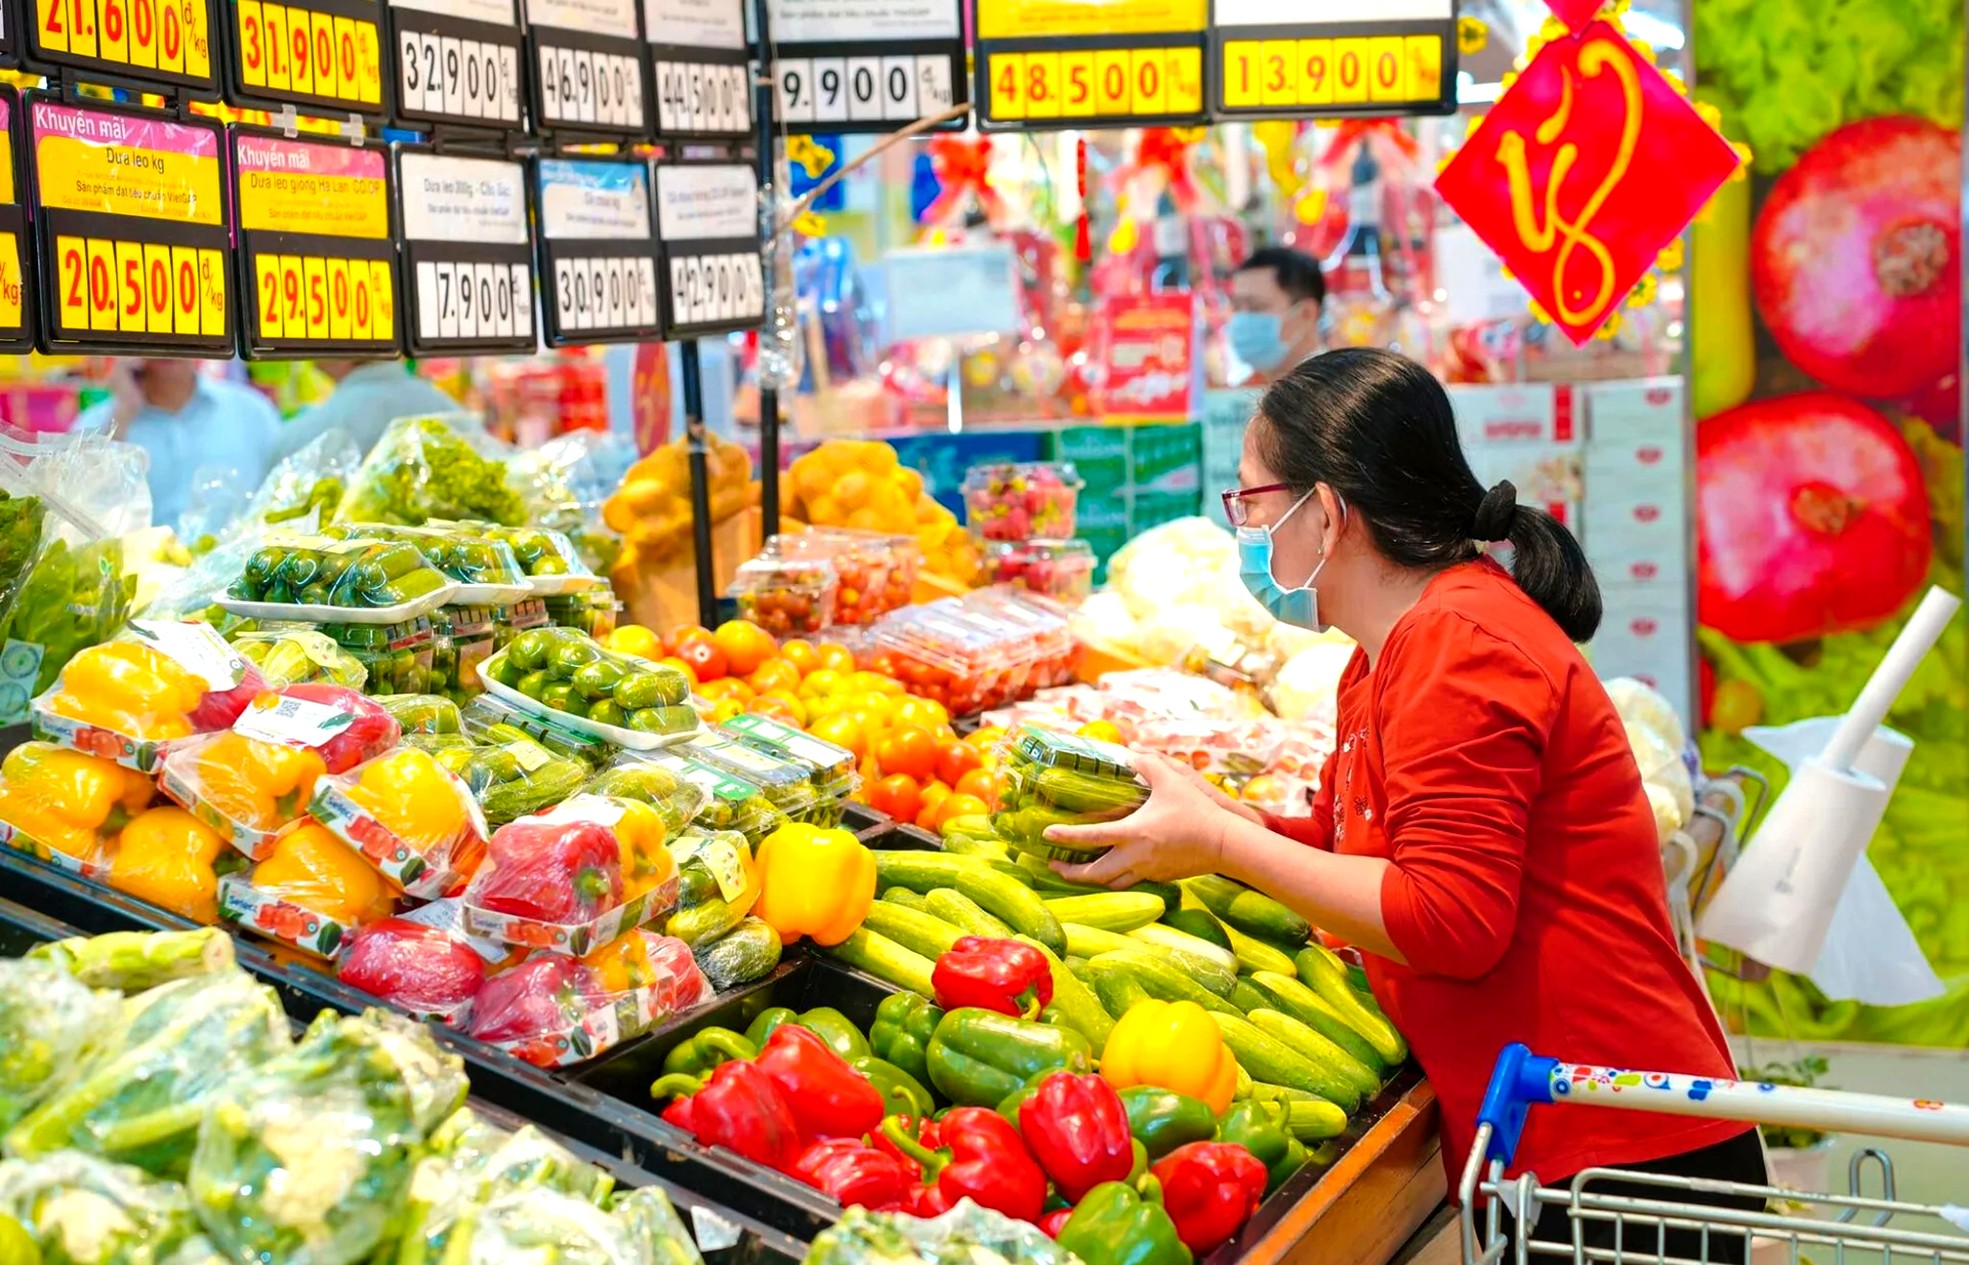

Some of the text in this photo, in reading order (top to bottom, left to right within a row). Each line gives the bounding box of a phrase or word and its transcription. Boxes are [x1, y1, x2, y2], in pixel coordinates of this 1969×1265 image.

[46, 0, 180, 60] 21.600
[245, 15, 355, 81] 31.900
[406, 42, 496, 102] 32.900
[546, 58, 625, 107] 46.900
[755, 66, 907, 108] 9.900
[997, 61, 1158, 104] 48.500
[1238, 51, 1398, 93] 13.900
[35, 105, 126, 139] Khuyến mãi
[133, 151, 149, 168] leo
[152, 154, 164, 175] kg
[65, 249, 196, 316] 20.500
[264, 269, 368, 328] 29.500
[440, 272, 508, 322] 7.900
[561, 269, 635, 313] 30.900
